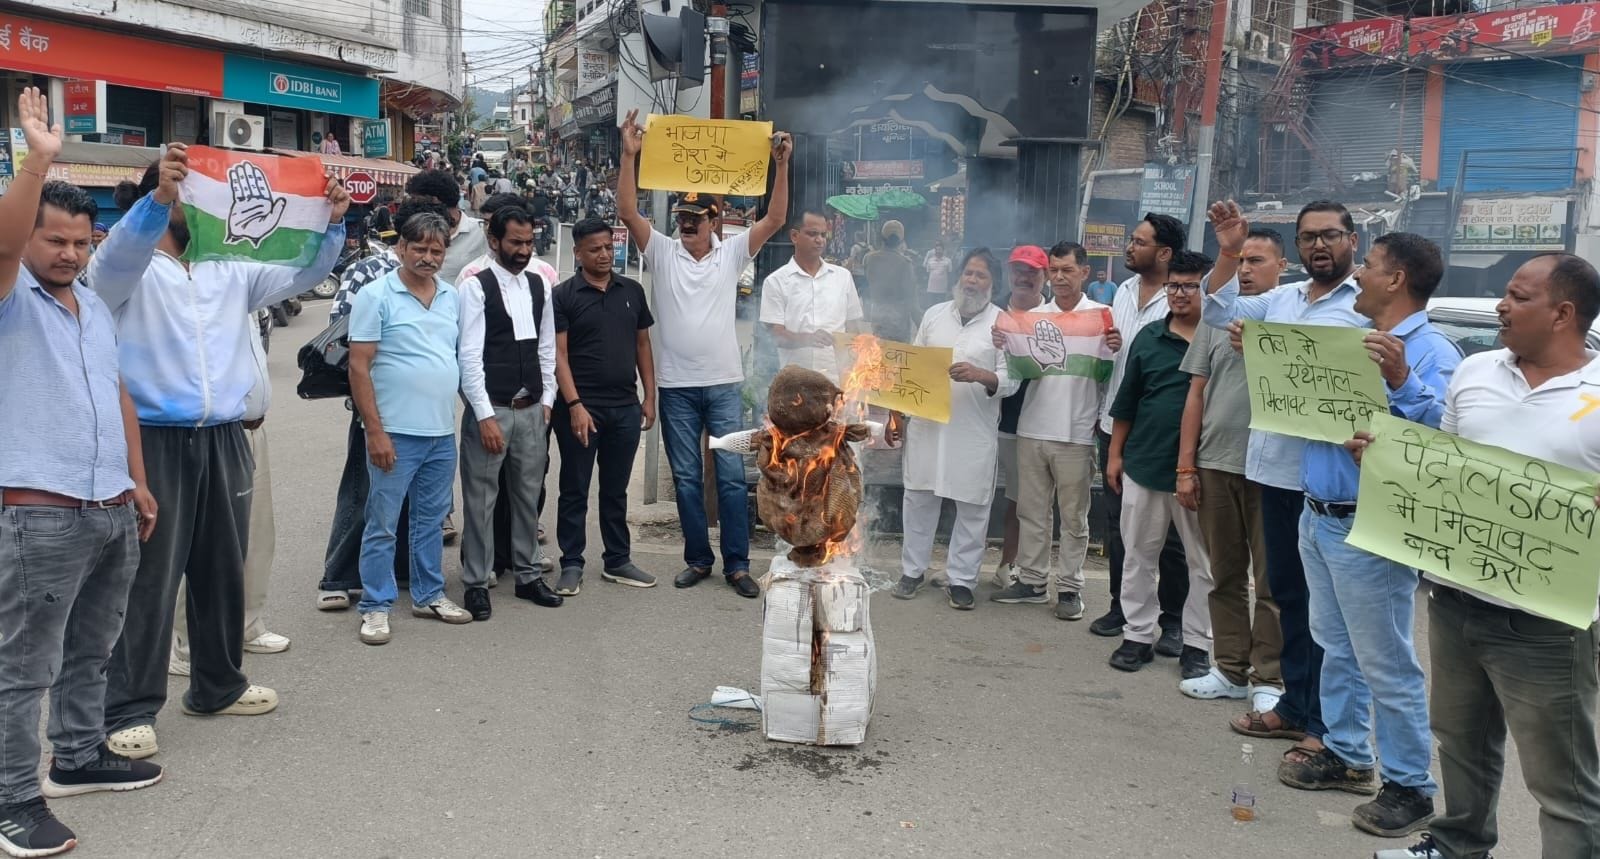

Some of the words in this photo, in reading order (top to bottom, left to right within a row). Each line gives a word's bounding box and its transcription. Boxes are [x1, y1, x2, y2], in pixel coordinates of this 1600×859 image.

[19, 26, 49, 53] बैंक
[291, 80, 313, 94] IDBI
[315, 86, 338, 98] BANK
[365, 124, 385, 139] ATM
[666, 125, 736, 145] भाजपा
[686, 163, 738, 184] आओ
[346, 181, 375, 195] STOP
[1153, 181, 1177, 191] SCHOOL
[1257, 325, 1289, 355] तेल
[885, 347, 918, 366] का
[890, 380, 931, 405] करो
[1256, 376, 1309, 417] मिलावट
[1392, 428, 1511, 505] पेट्रोल
[1383, 481, 1421, 523] में
[1422, 490, 1580, 571] मिलावट
